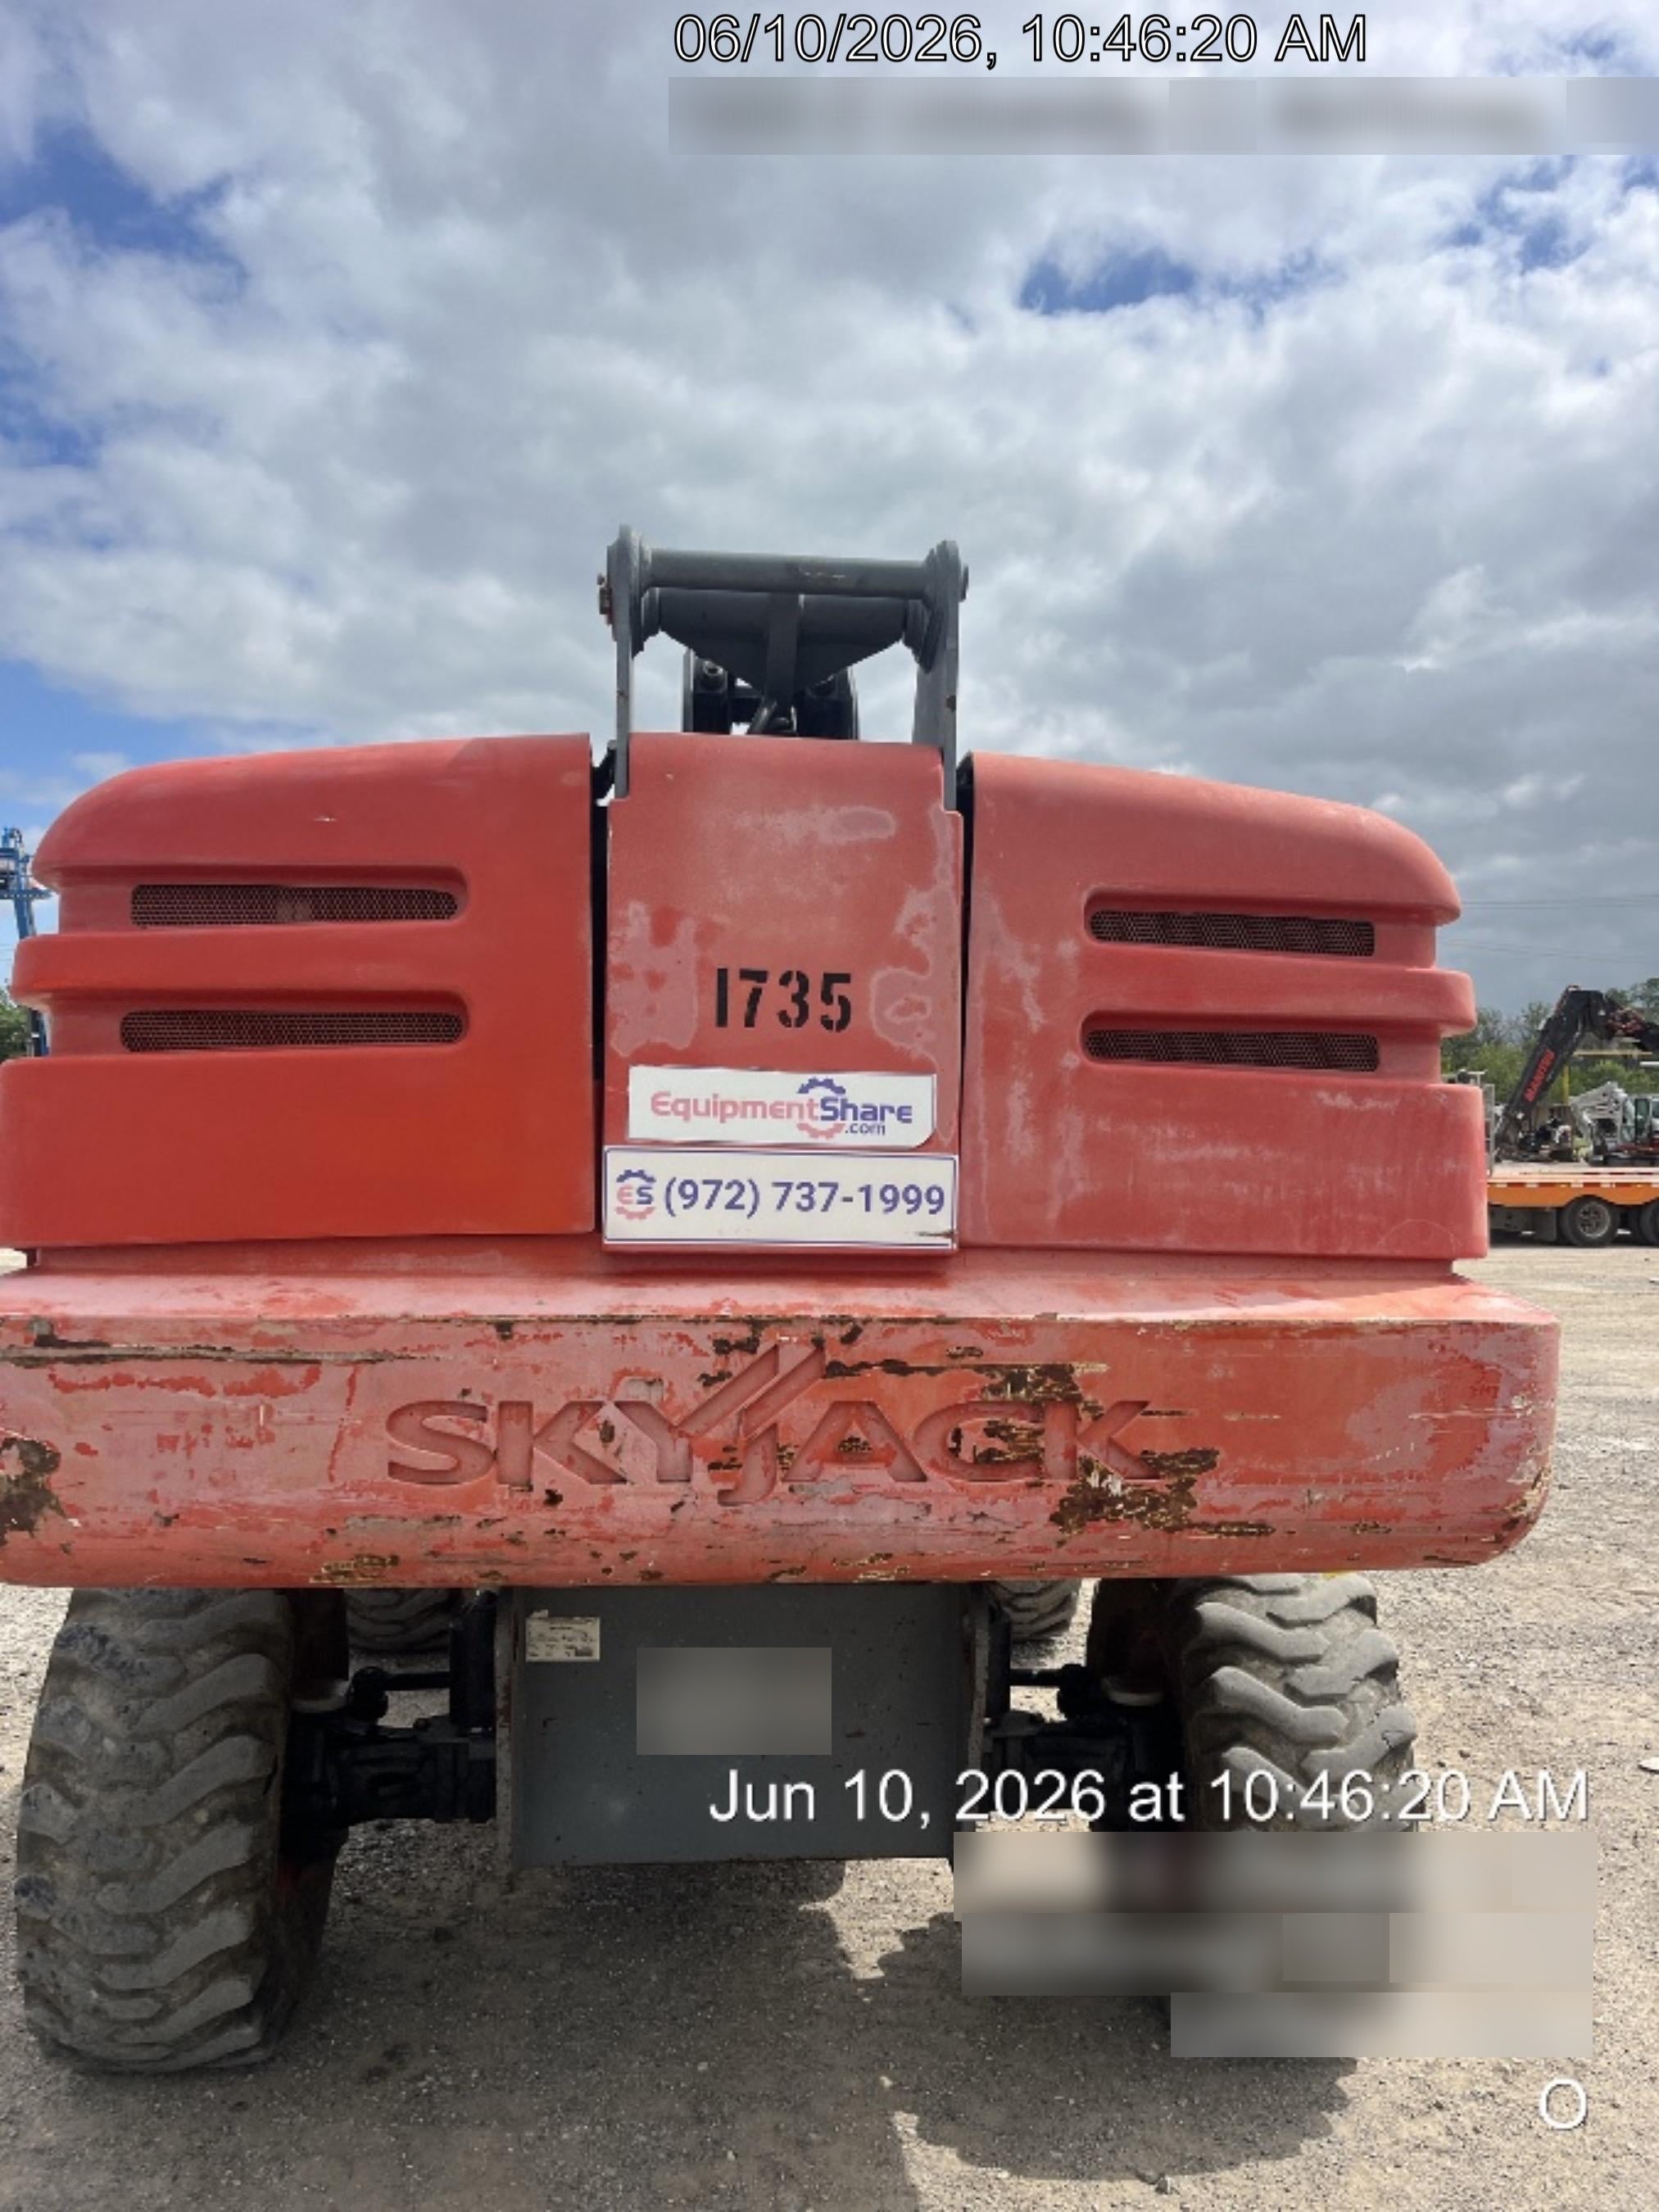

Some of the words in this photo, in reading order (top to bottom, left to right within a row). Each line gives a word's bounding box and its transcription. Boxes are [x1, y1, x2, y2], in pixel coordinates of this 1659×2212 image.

[715, 968, 852, 1032] 1735
[650, 1090, 913, 1125] EquipmentShare
[664, 1176, 760, 1219] (972)
[772, 1181, 945, 1216] 737-1999
[386, 1340, 1162, 1506] SKYJACK
